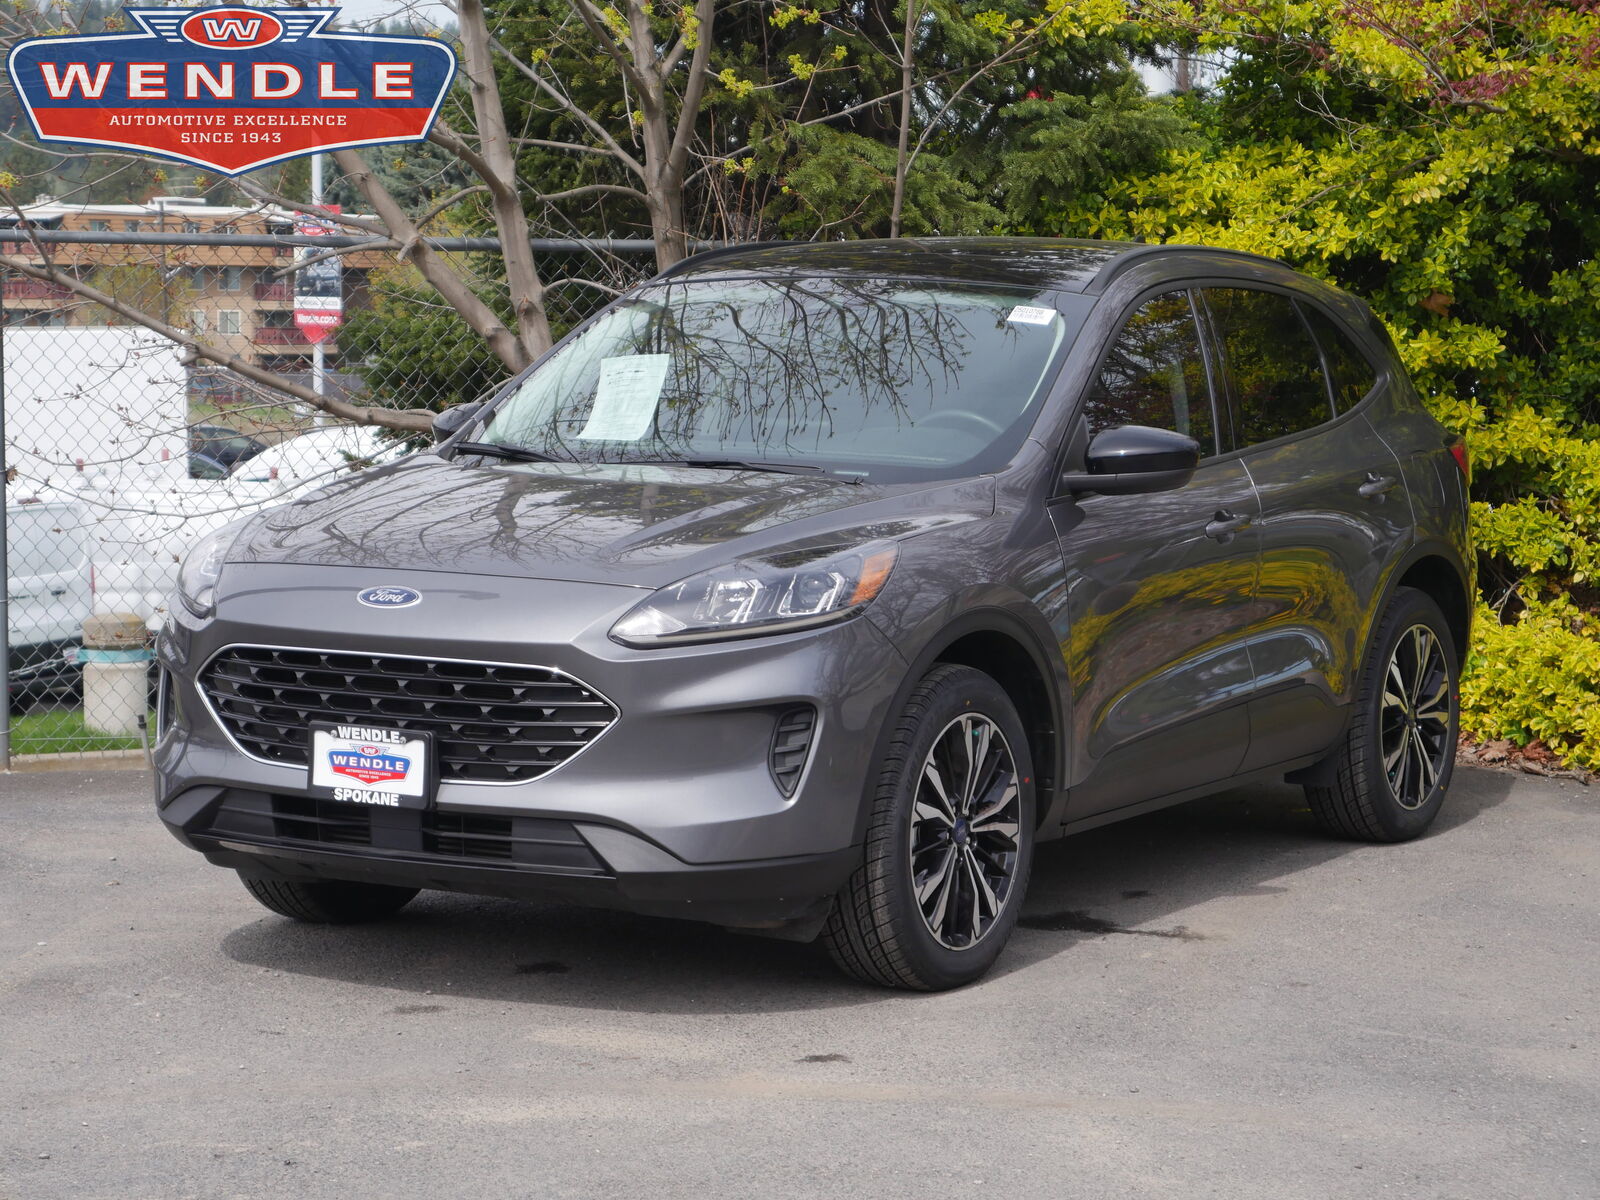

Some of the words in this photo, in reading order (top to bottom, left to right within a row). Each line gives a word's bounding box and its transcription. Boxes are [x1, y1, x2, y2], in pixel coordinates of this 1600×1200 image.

[370, 589, 407, 603] Ford
[337, 726, 400, 744] WENDLE
[333, 755, 404, 771] WENDLE
[333, 787, 399, 806] SPOKANE
